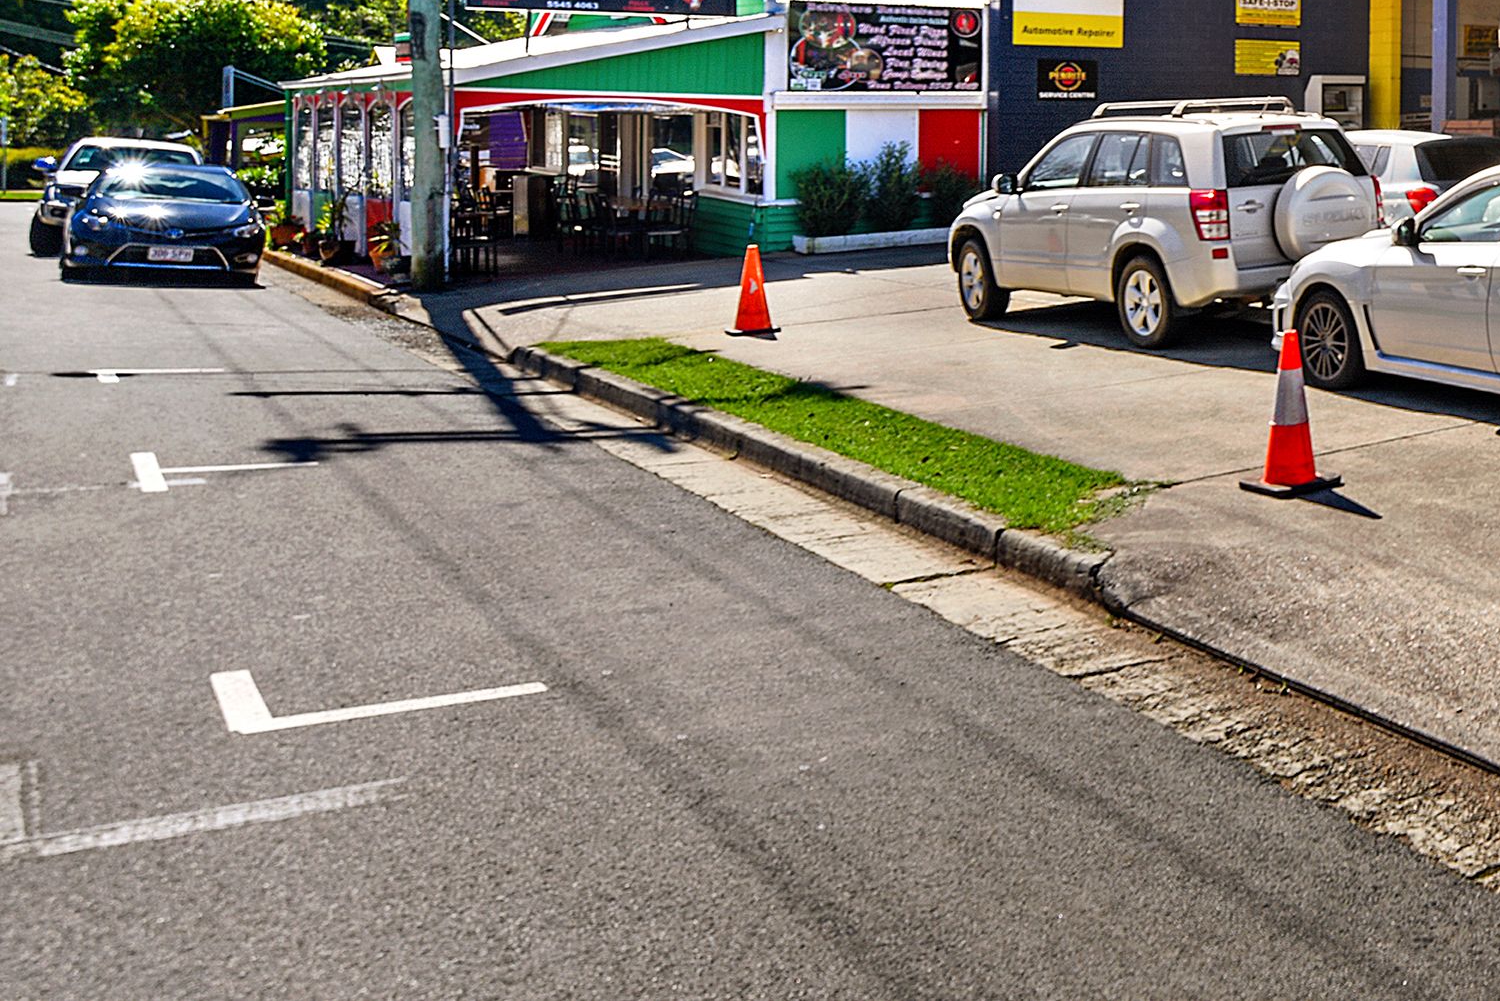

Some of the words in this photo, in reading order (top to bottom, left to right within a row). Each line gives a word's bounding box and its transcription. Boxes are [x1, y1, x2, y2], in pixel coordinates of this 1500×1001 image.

[546, 0, 572, 9] 5545
[573, 1, 600, 10] 4063
[1022, 25, 1074, 36] Automotive
[1076, 27, 1116, 39] Repairer
[1038, 91, 1068, 99] SERVICE
[1069, 91, 1096, 99] CENTRE
